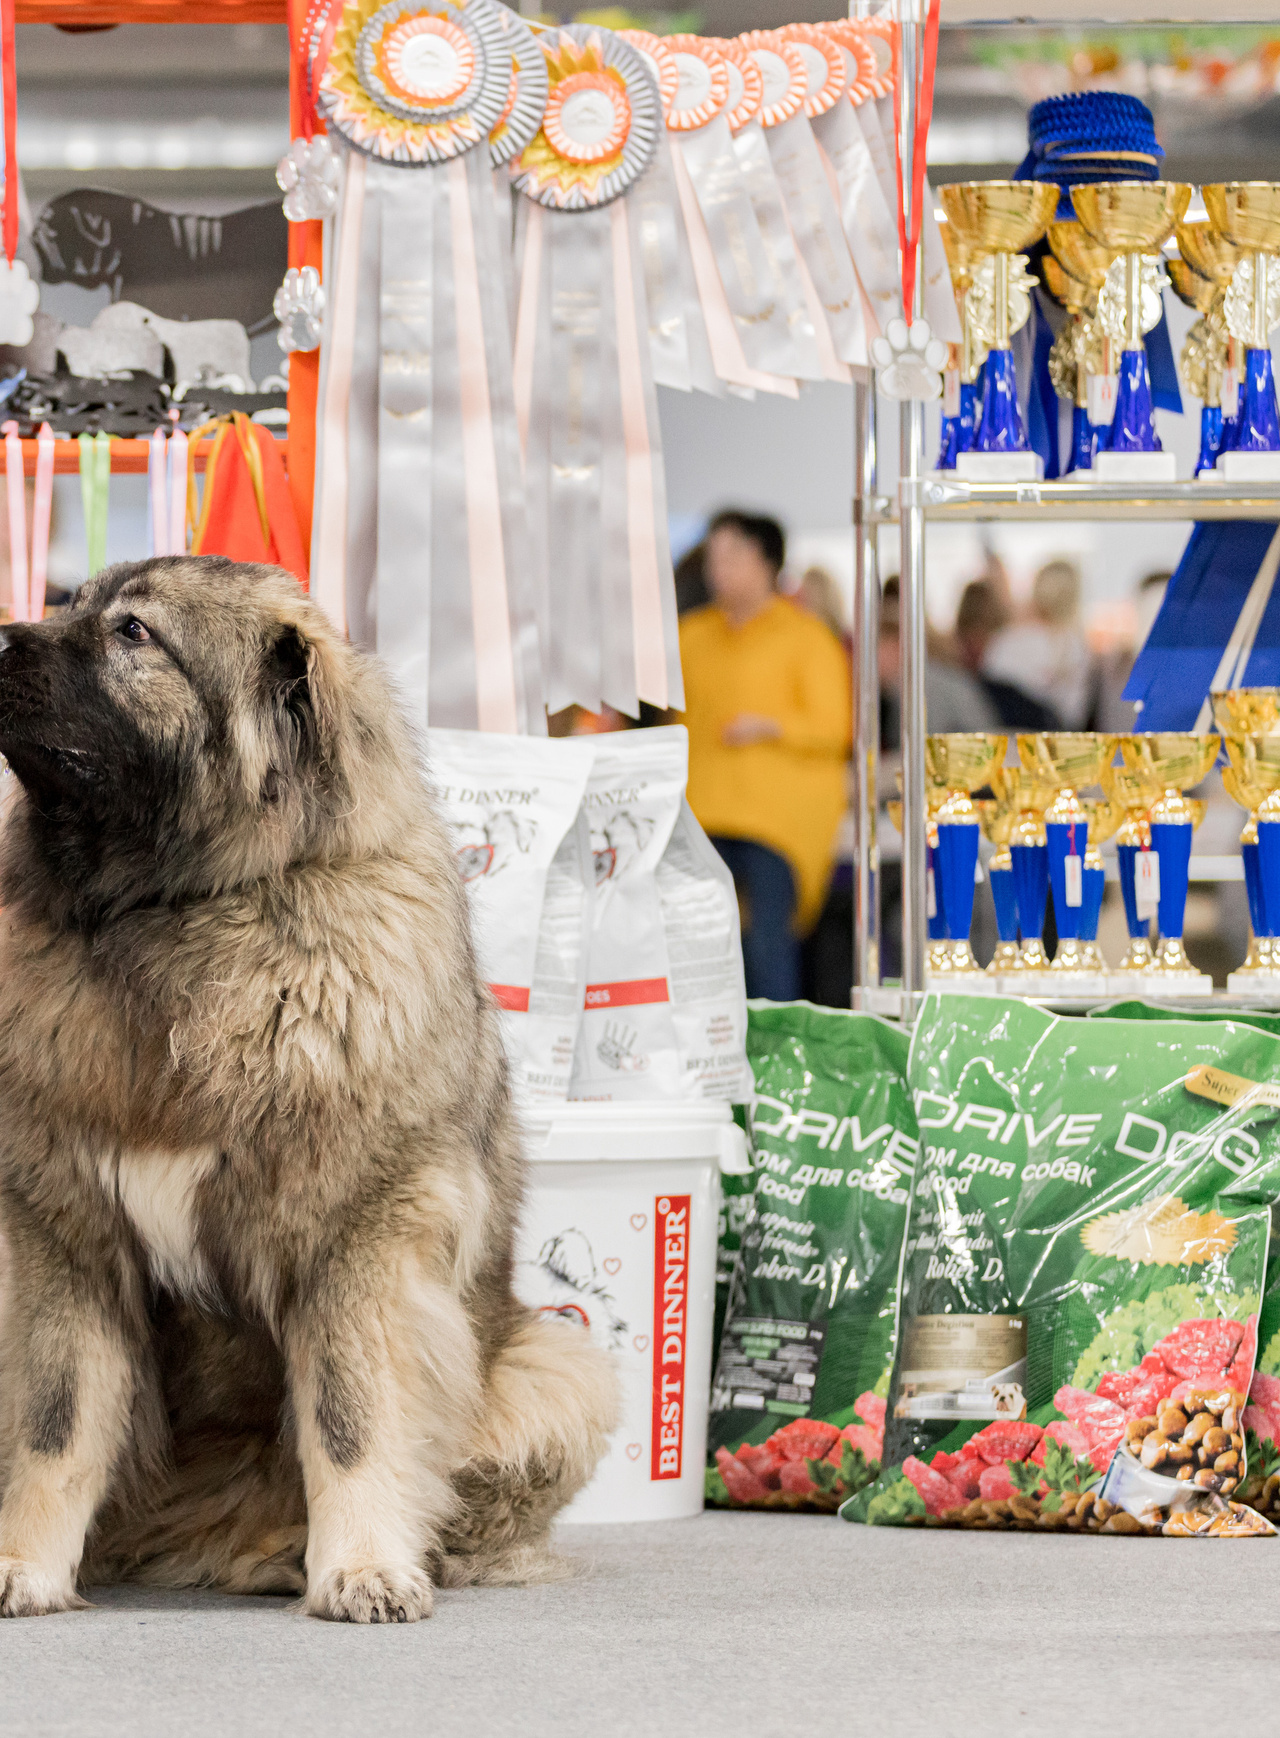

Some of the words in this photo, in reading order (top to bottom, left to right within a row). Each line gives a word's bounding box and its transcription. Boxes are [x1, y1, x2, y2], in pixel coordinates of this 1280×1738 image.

[1201, 1070, 1239, 1097] Super
[750, 1093, 918, 1176] DRIVE
[913, 1089, 1103, 1148] DRIVE
[1114, 1111, 1261, 1177] DOG
[790, 1163, 844, 1188] для
[958, 1152, 1017, 1180] для
[1020, 1155, 1098, 1189] собак
[662, 1206, 687, 1366] DINNER
[981, 1257, 1006, 1282] D.
[659, 1374, 681, 1475] BEST
